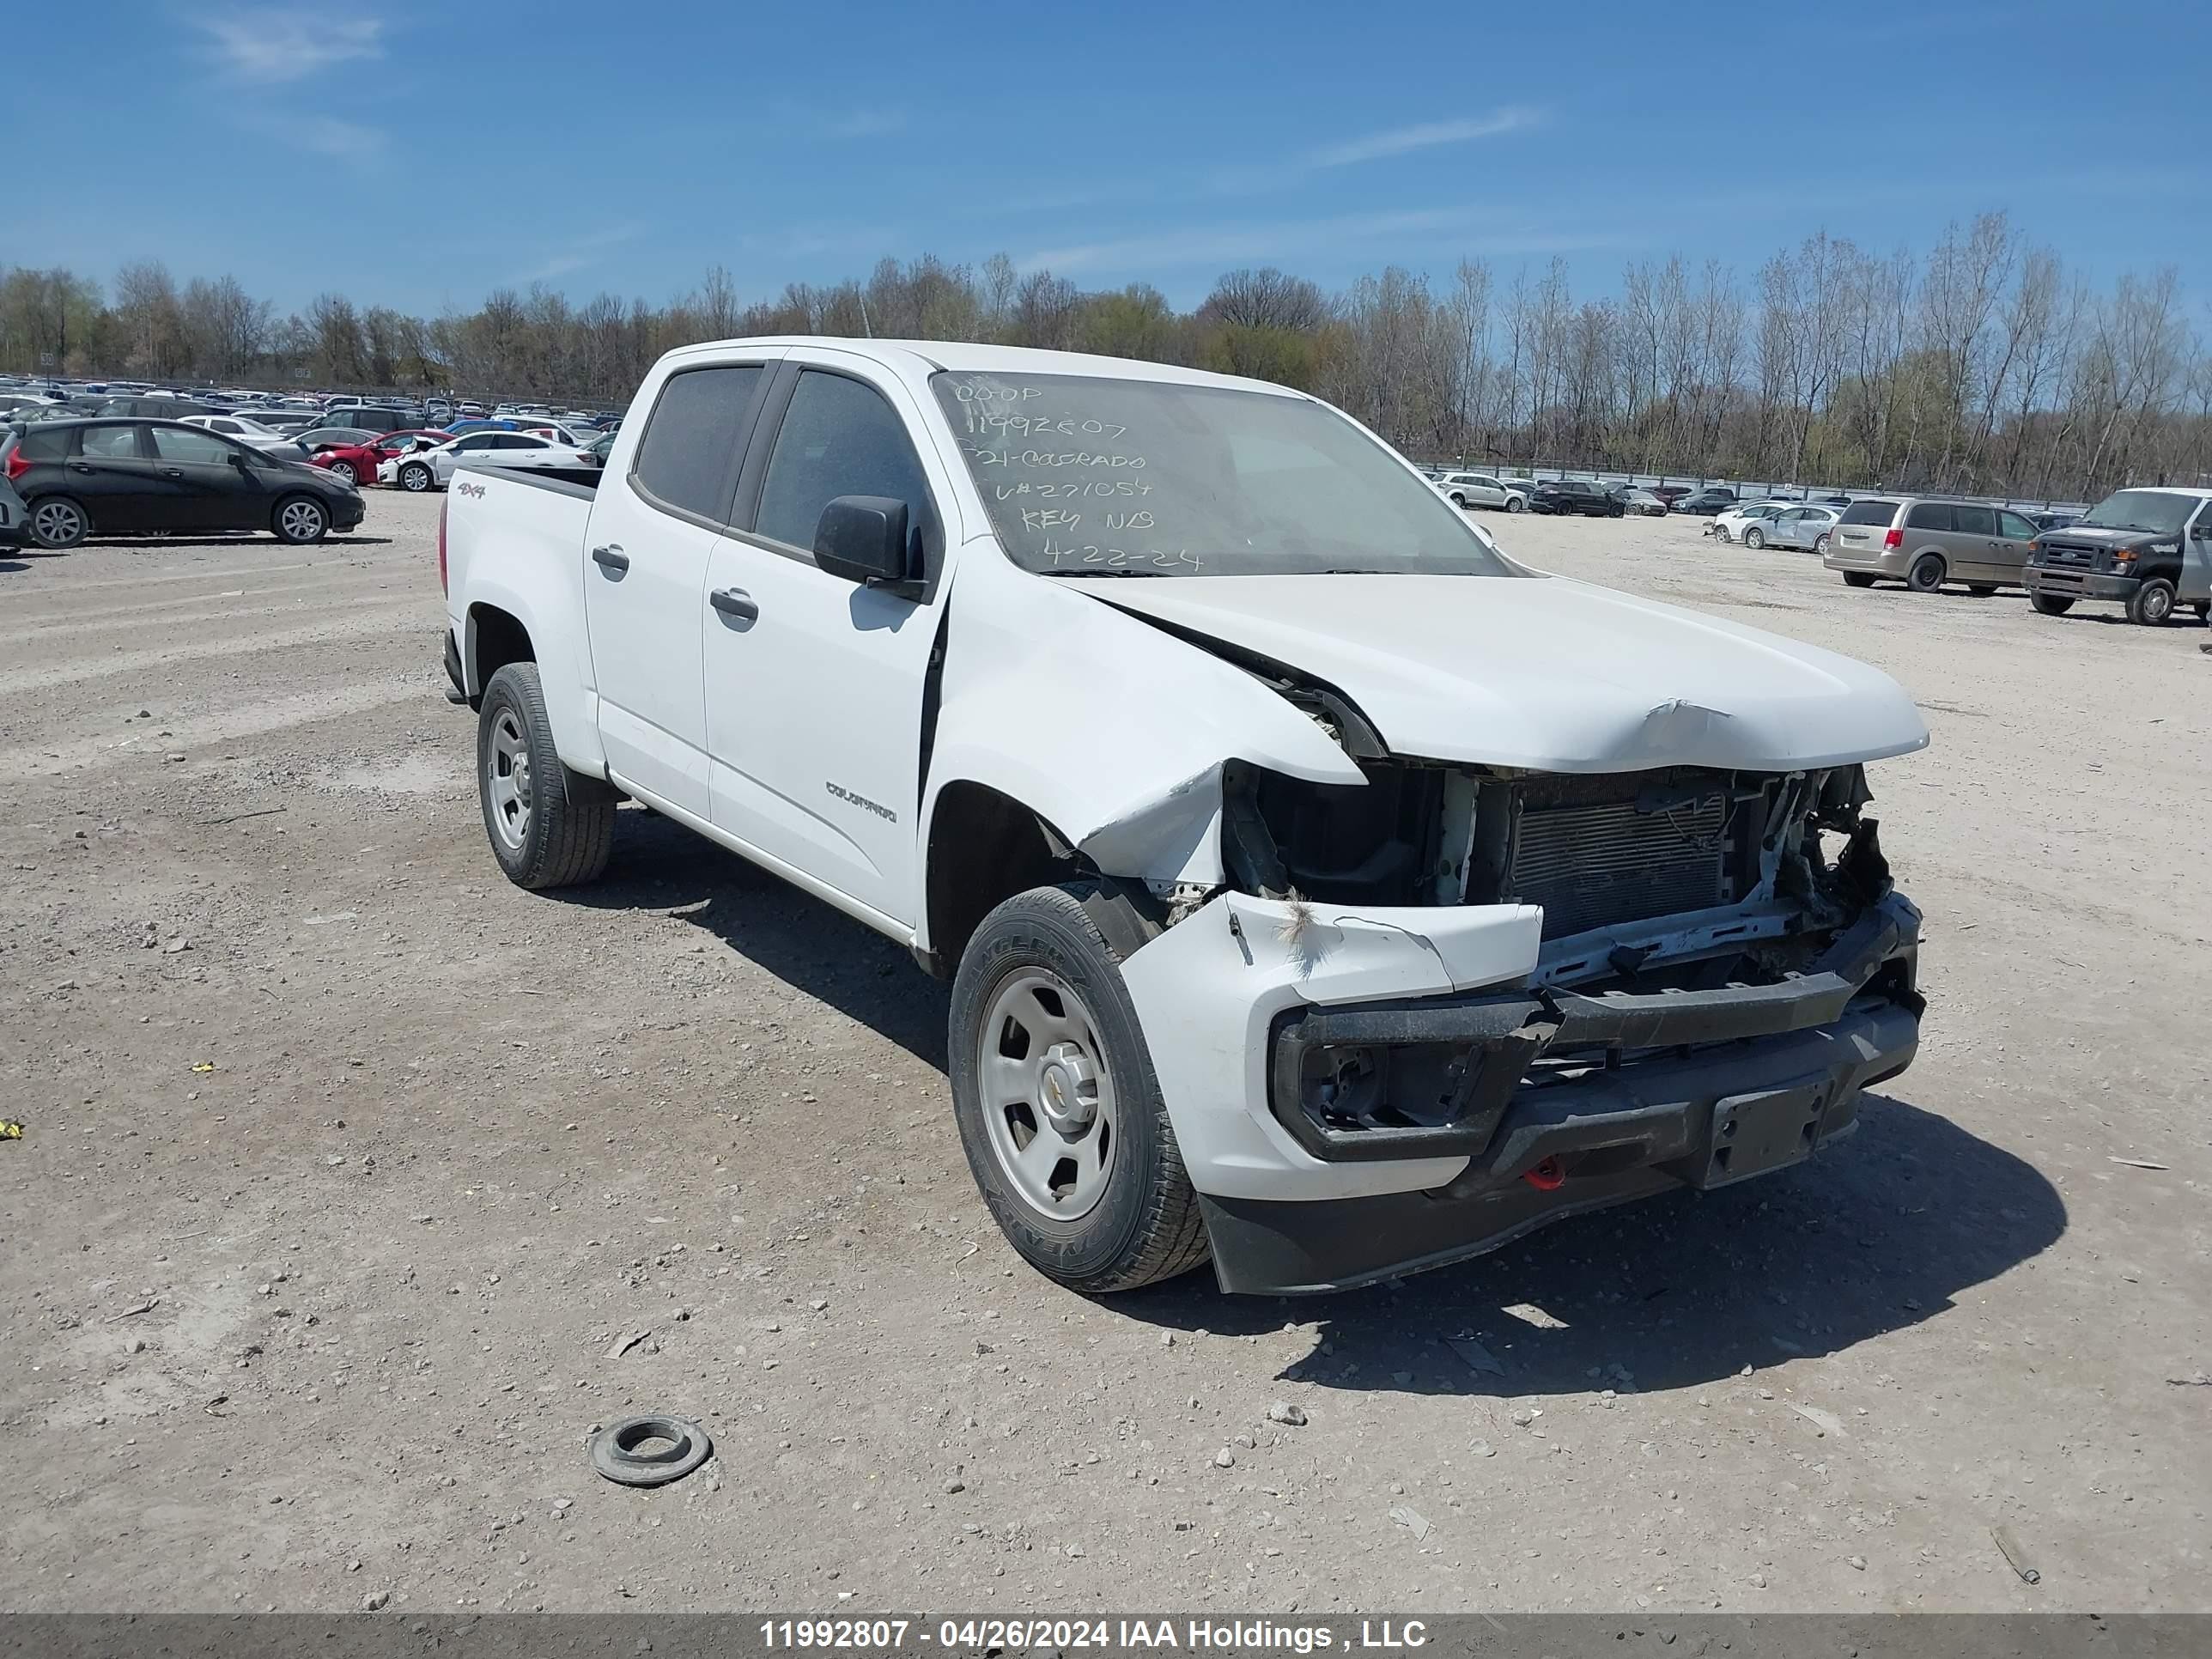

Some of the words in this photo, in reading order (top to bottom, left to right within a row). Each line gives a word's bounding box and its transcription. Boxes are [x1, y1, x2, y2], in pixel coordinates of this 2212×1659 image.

[1021, 507, 1081, 532] KEY
[1043, 537, 1205, 572] 4-22-24
[826, 781, 897, 823] COLORADO
